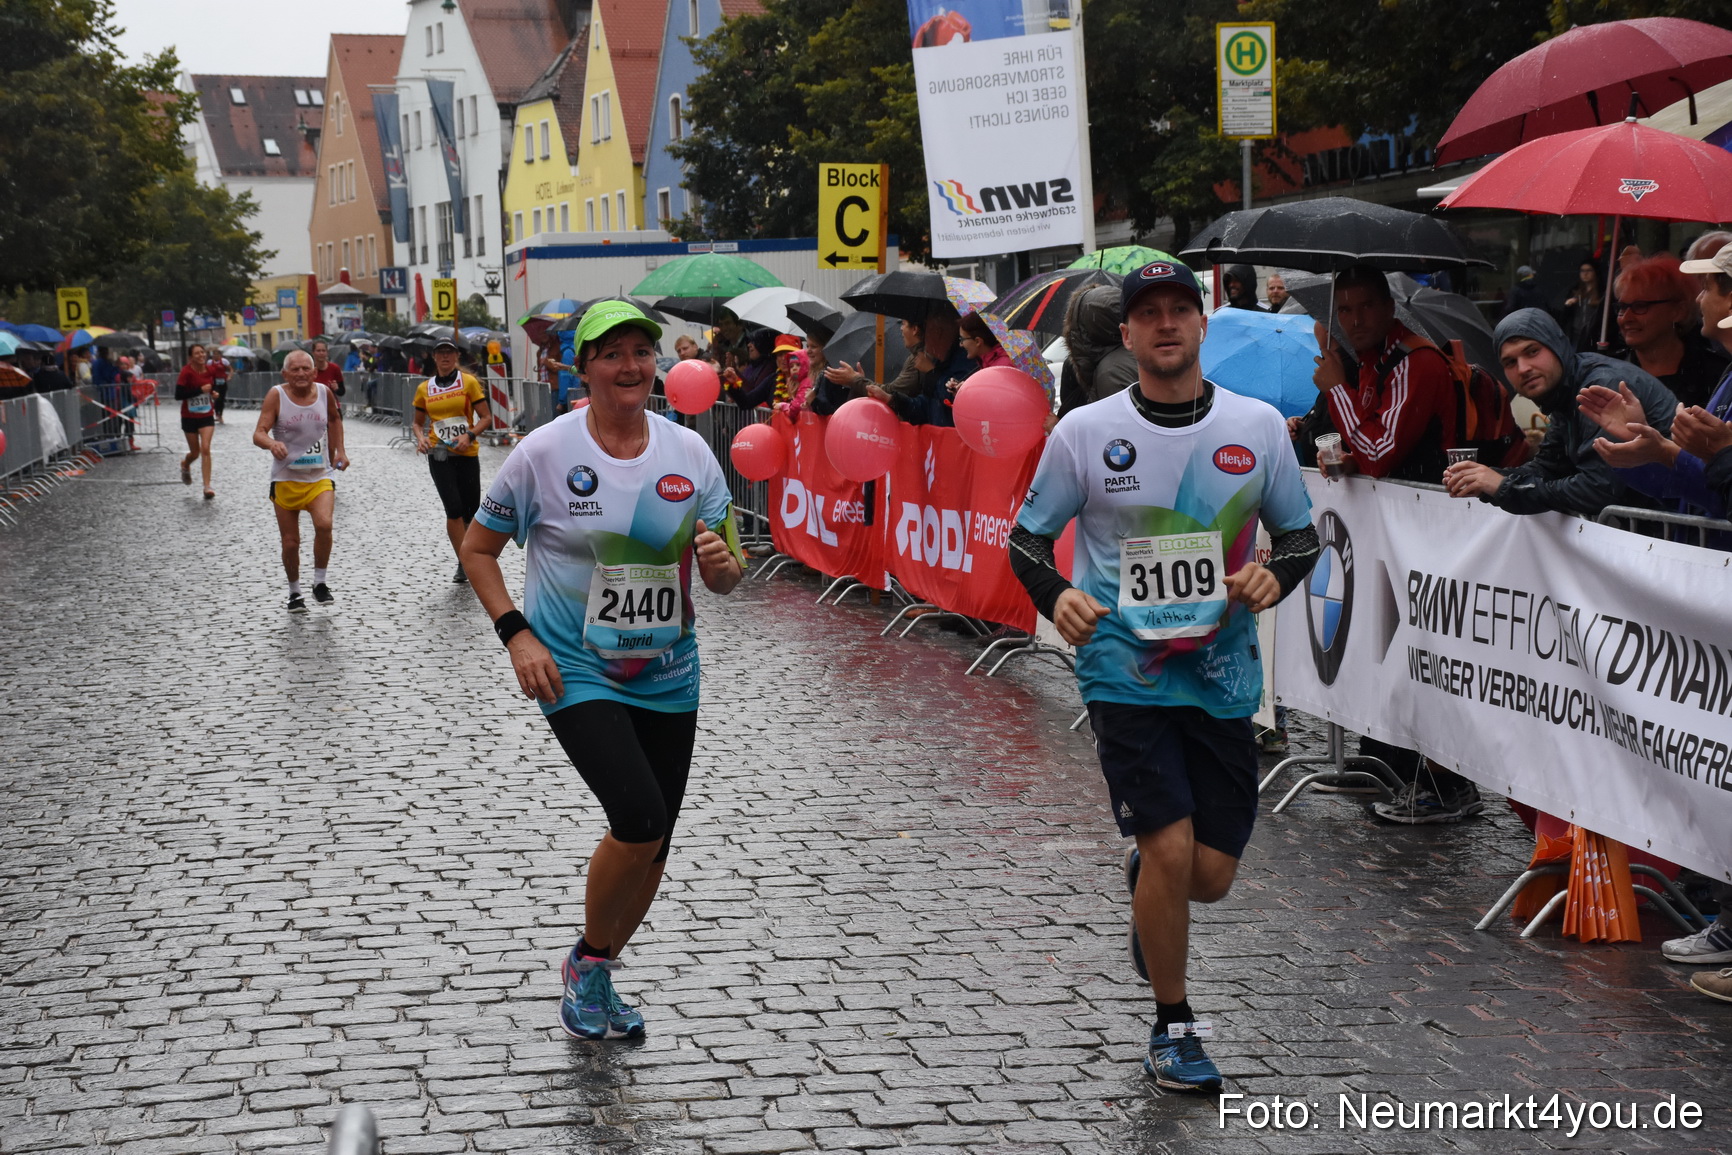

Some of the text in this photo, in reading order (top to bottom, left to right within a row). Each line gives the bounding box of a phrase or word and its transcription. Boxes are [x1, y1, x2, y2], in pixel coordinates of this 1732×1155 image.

[1229, 80, 1264, 88] Marktplatz
[827, 168, 880, 187] Block
[535, 182, 553, 200] HOTEL
[835, 195, 870, 247] C
[433, 280, 455, 288] Block
[438, 291, 451, 311] D
[66, 301, 82, 321] D
[439, 424, 467, 440] 2738
[1106, 440, 1133, 451] BMW
[1219, 452, 1252, 467] Hervis
[569, 466, 595, 477] BMW
[661, 481, 691, 495] Hervis
[1104, 475, 1140, 486] PARTL
[1105, 484, 1141, 494] Neumarkt
[569, 501, 603, 510] PARTL
[569, 509, 604, 518] Neumarkt
[1159, 536, 1213, 552] BOCK
[1125, 549, 1154, 557] NeuerMarkt
[630, 568, 676, 580] BOCK
[1130, 558, 1215, 602] 3109
[598, 587, 676, 625] 2440
[1408, 570, 1469, 639] BMW
[1144, 609, 1197, 627] Matthias
[617, 634, 653, 649] Ingrid
[653, 662, 692, 682] Stadtlauf
[1407, 645, 1474, 700] WENIGER
[1479, 664, 1601, 736] VERBRAUCH.
[1598, 700, 1643, 758] MEHR
